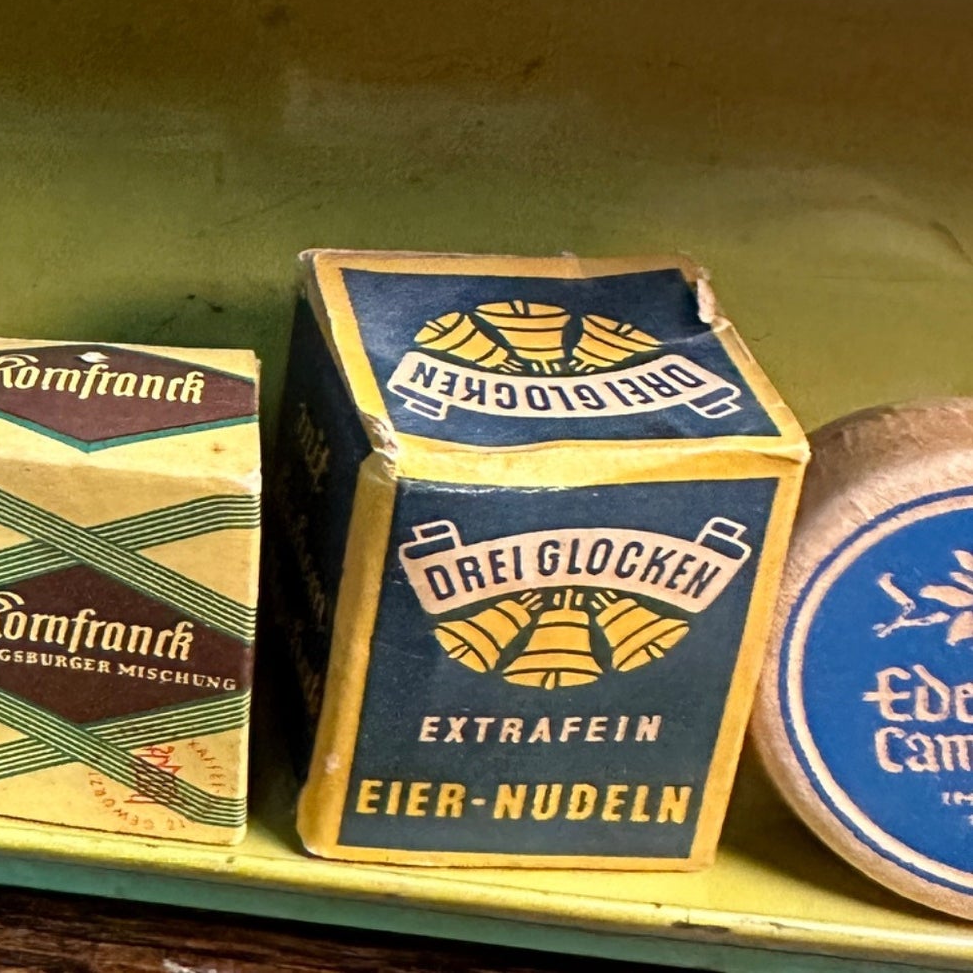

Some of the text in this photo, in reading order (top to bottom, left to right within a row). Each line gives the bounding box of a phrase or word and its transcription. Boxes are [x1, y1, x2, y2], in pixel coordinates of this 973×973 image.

[409, 361, 707, 411] DREI GLOCKEN
[424, 538, 721, 601] DREI GLOCKEN
[117, 662, 237, 692] MISCHUNG
[418, 715, 664, 744] EXTRAFEIN
[355, 779, 693, 824] EIER-NUDELN
